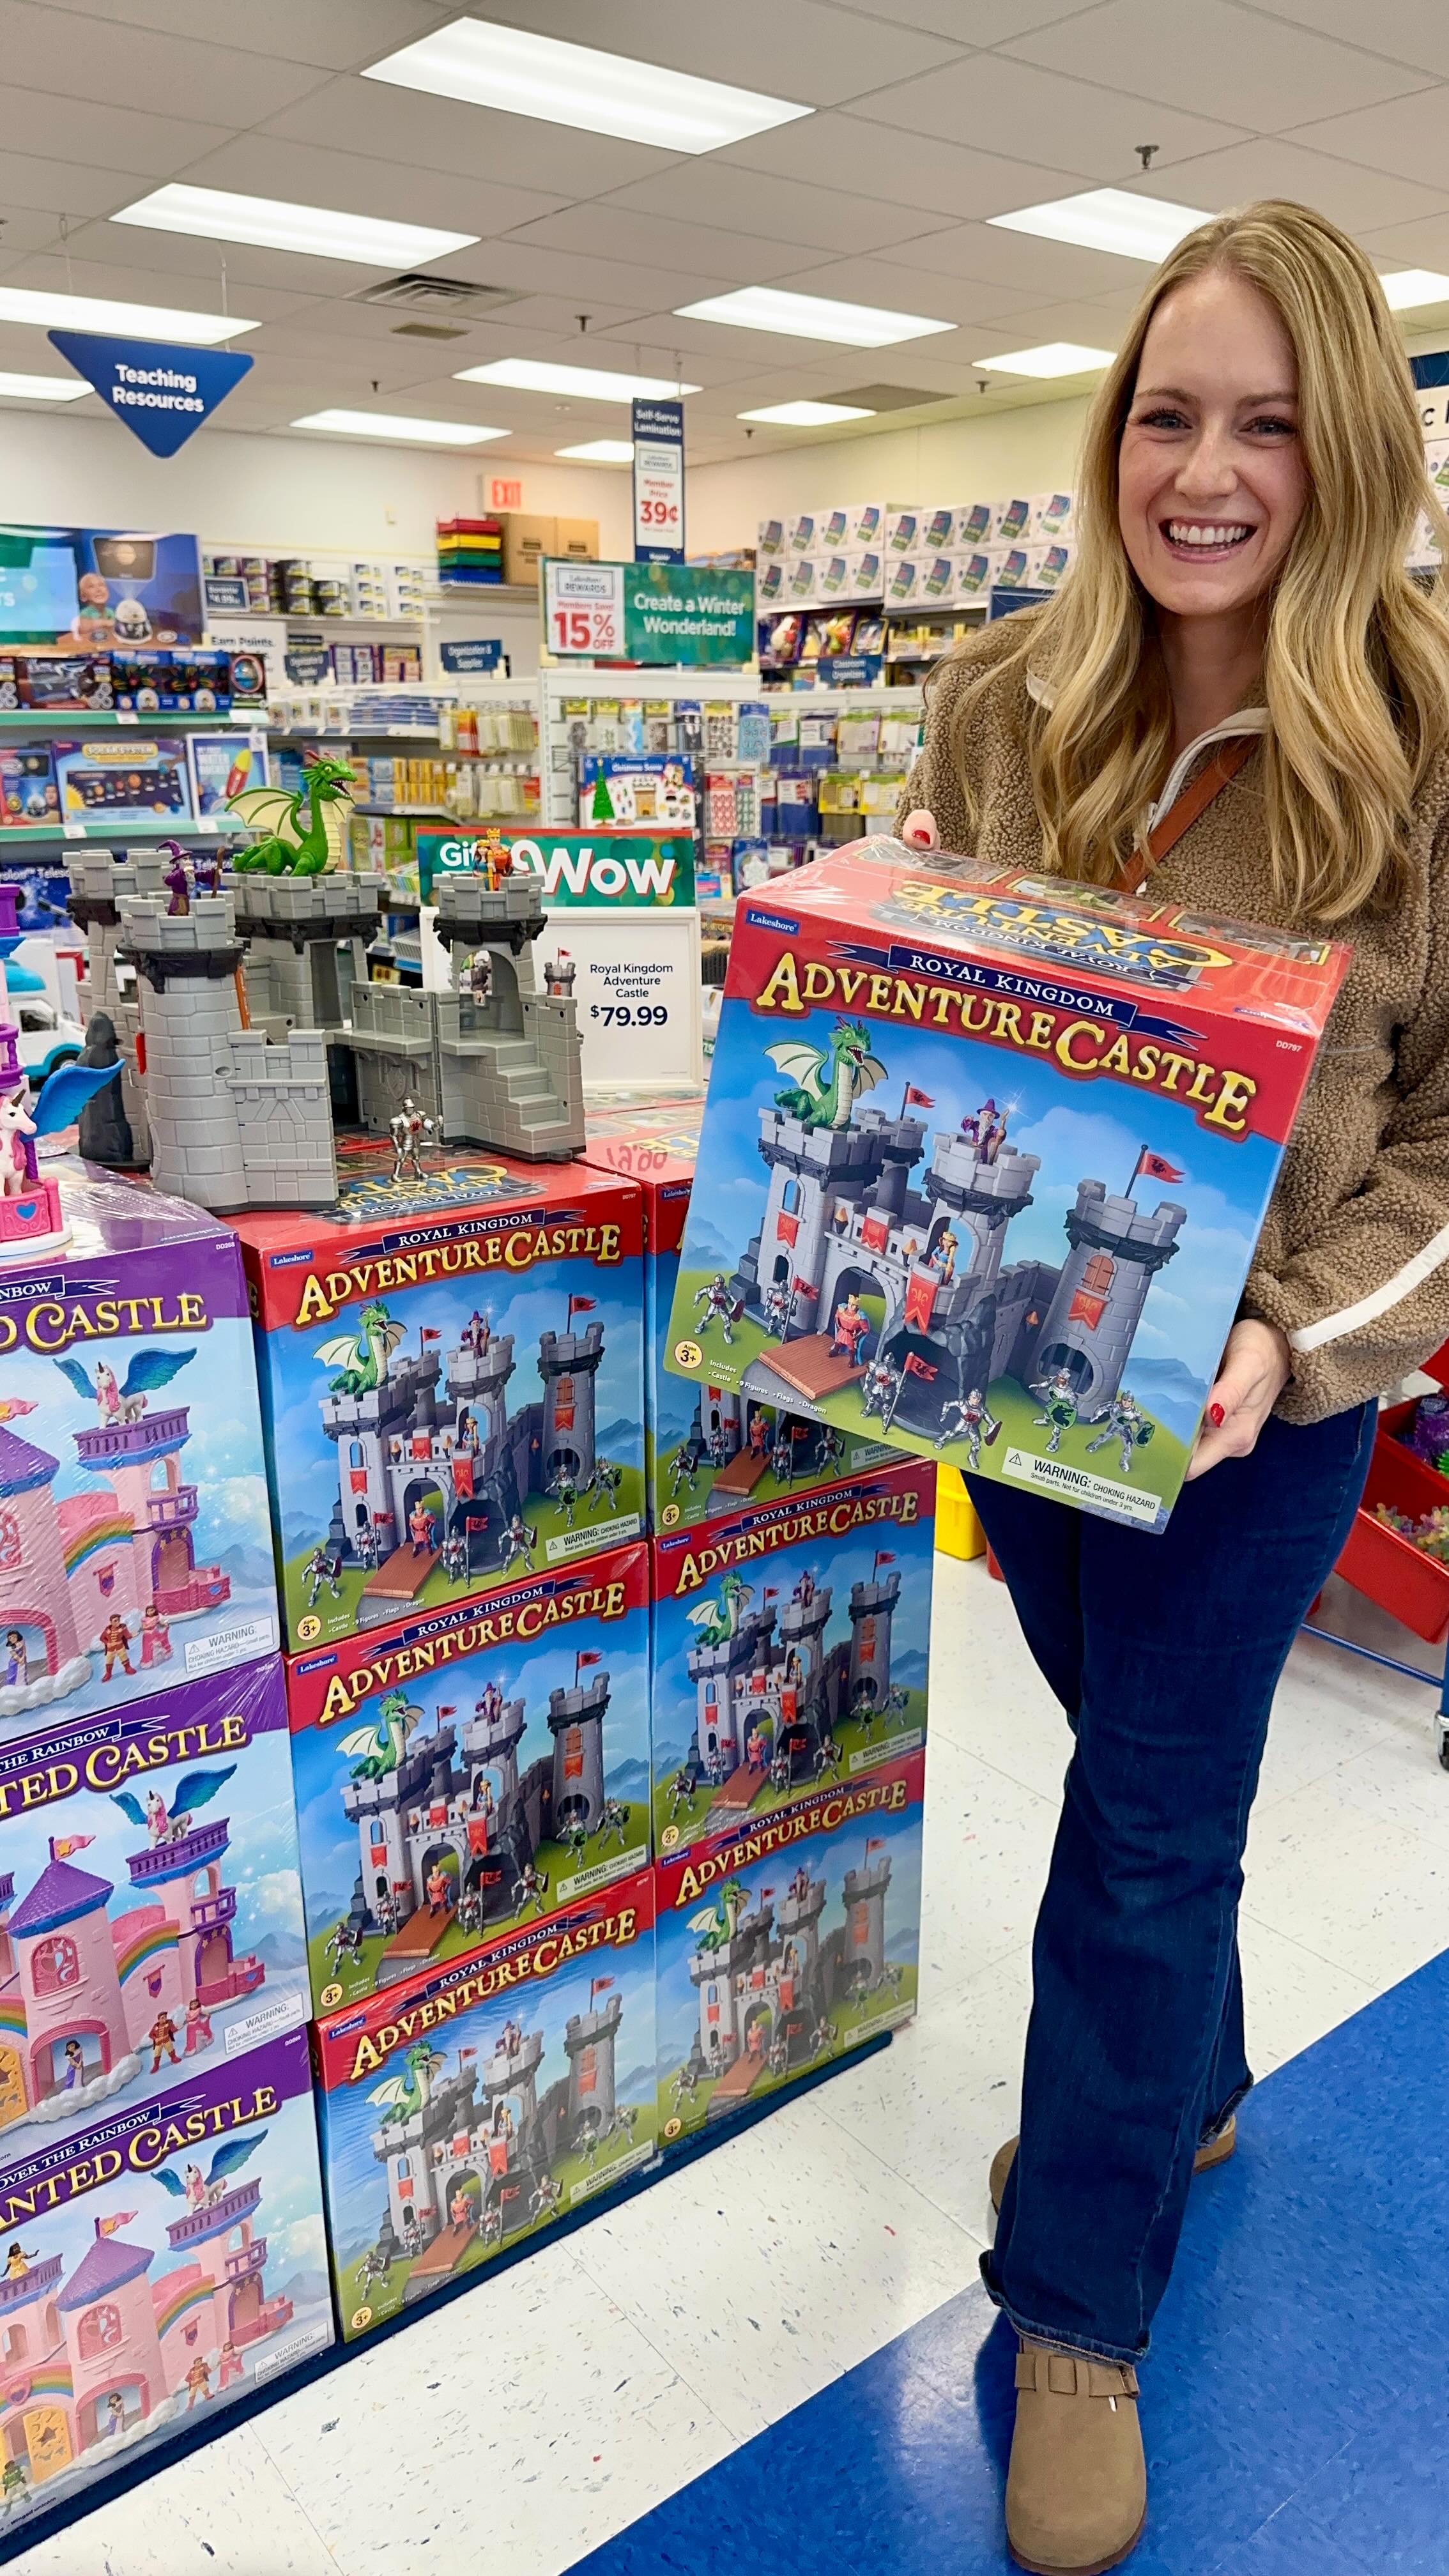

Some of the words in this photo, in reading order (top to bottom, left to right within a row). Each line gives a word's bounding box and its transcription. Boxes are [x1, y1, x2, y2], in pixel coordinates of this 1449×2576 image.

[114, 363, 197, 393] Teaching
[112, 385, 204, 413] Resources
[635, 408, 680, 424] Self-Serve
[491, 479, 522, 509] EXIT
[640, 500, 678, 525] 39¢
[565, 582, 607, 594] REWARDS
[633, 592, 677, 613] Create
[685, 601, 694, 613] a
[697, 595, 746, 616] Winter
[643, 616, 737, 637] Wonderland!
[593, 638, 615, 650] OFF
[590, 963, 621, 974] Royal
[624, 963, 673, 975] Kingdom
[603, 975, 661, 986] Adventure
[615, 988, 650, 999] Castle
[909, 954, 986, 985] ROYAL
[994, 976, 1114, 1017] KINGDOM
[590, 1004, 668, 1027] $79.99
[1275, 1039, 1303, 1053] DD797
[398, 1227, 452, 1246] ROYAL
[457, 1212, 533, 1234] KINGDOM
[26, 1292, 208, 1351] CASTLE
[680, 1349, 696, 1363] 3+
[710, 1360, 737, 1374] Includes
[744, 1382, 769, 1395] Figures
[777, 1392, 794, 1404] Flags
[802, 1400, 827, 1414] Dragon
[1030, 1471, 1046, 1482] Small
[1046, 1477, 1061, 1488] parts.
[1062, 1482, 1072, 1491] Not
[1081, 1487, 1102, 1501] children
[1103, 1496, 1119, 1506] under
[1124, 1503, 1134, 1512] yrs.
[1034, 1459, 1092, 1489] WARNING:
[1093, 1482, 1125, 1500] CHOKING
[1126, 1494, 1156, 1510] HAZARD
[666, 1512, 676, 1522] 3+
[752, 1507, 792, 1526] ROYAL
[795, 1489, 853, 1510] KINGDOM
[564, 1528, 600, 1546] WARNING:
[601, 1523, 620, 1534] CHOKING
[620, 1517, 638, 1528] HAZARD
[327, 1613, 351, 1625] Includes
[360, 1613, 379, 1623] Figures
[417, 1612, 468, 1637] ROYAL
[473, 1584, 544, 1616] KINGDOM
[303, 1625, 317, 1637] 3+
[32, 1727, 110, 1760] RAINBOW
[86, 1715, 249, 1788] CASTLE
[749, 1811, 788, 1833] ROYAL
[790, 1785, 845, 1816] KINGDOM
[440, 1958, 486, 1989] ROYAL
[491, 1924, 558, 1963] KINGDOM
[325, 1992, 339, 2004] 3+
[128, 2085, 277, 2171] CASTLE
[0, 2165, 41, 2189] OVER
[42, 2146, 76, 2167] THE
[79, 2112, 150, 2151] RAINBOW
